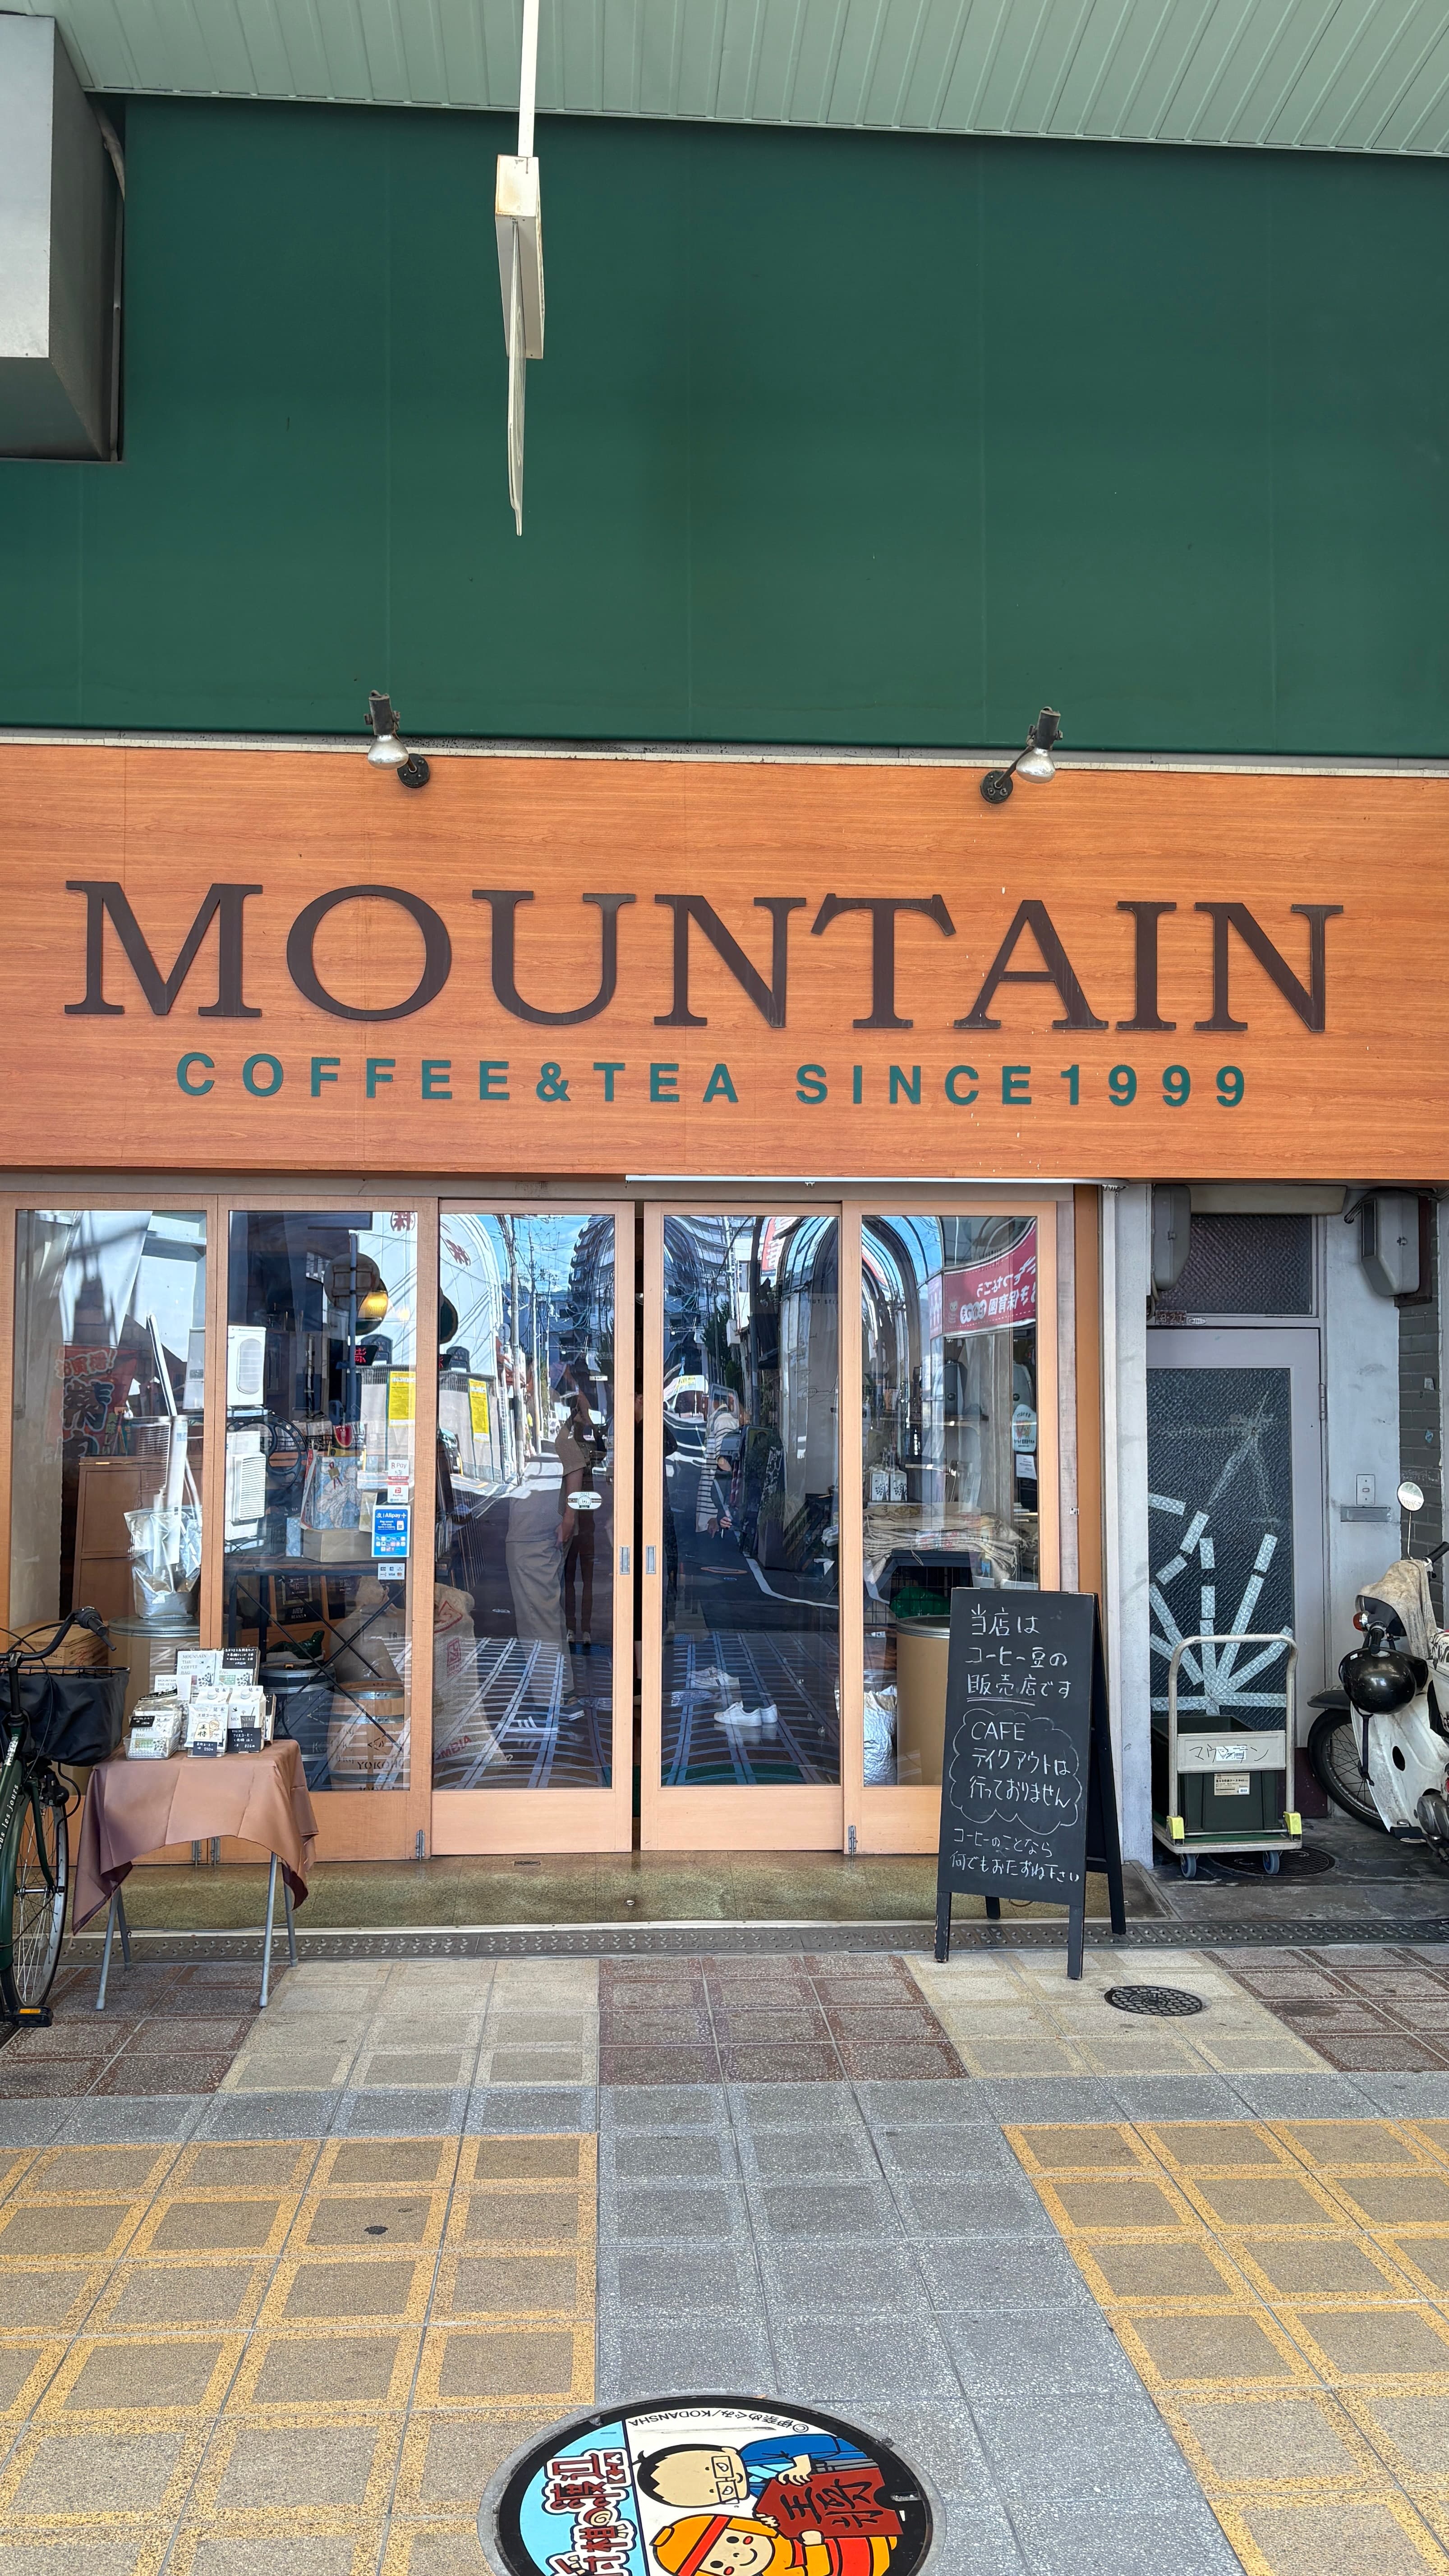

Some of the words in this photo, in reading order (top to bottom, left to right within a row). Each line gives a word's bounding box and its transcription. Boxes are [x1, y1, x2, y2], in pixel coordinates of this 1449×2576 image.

[64, 880, 1344, 1032] MOUNTAIN
[176, 1052, 737, 1103] COFFEE&TEA
[796, 1063, 1245, 1107] SINCE1999
[971, 1603, 1041, 1637] 当店は
[965, 1647, 1068, 1667] コーヒー豆の
[967, 1673, 1072, 1699] 販売店です
[971, 1721, 1026, 1742] CAFE
[971, 1747, 1072, 1776] テイクアウトは
[1, 1813, 10, 1828] les
[7, 1783, 19, 1812] jours
[970, 1778, 1072, 1808] 行っておりません
[954, 1828, 1053, 1858] コーヒーのことなら
[950, 1850, 1080, 1883] 何でもおたずね下さい
